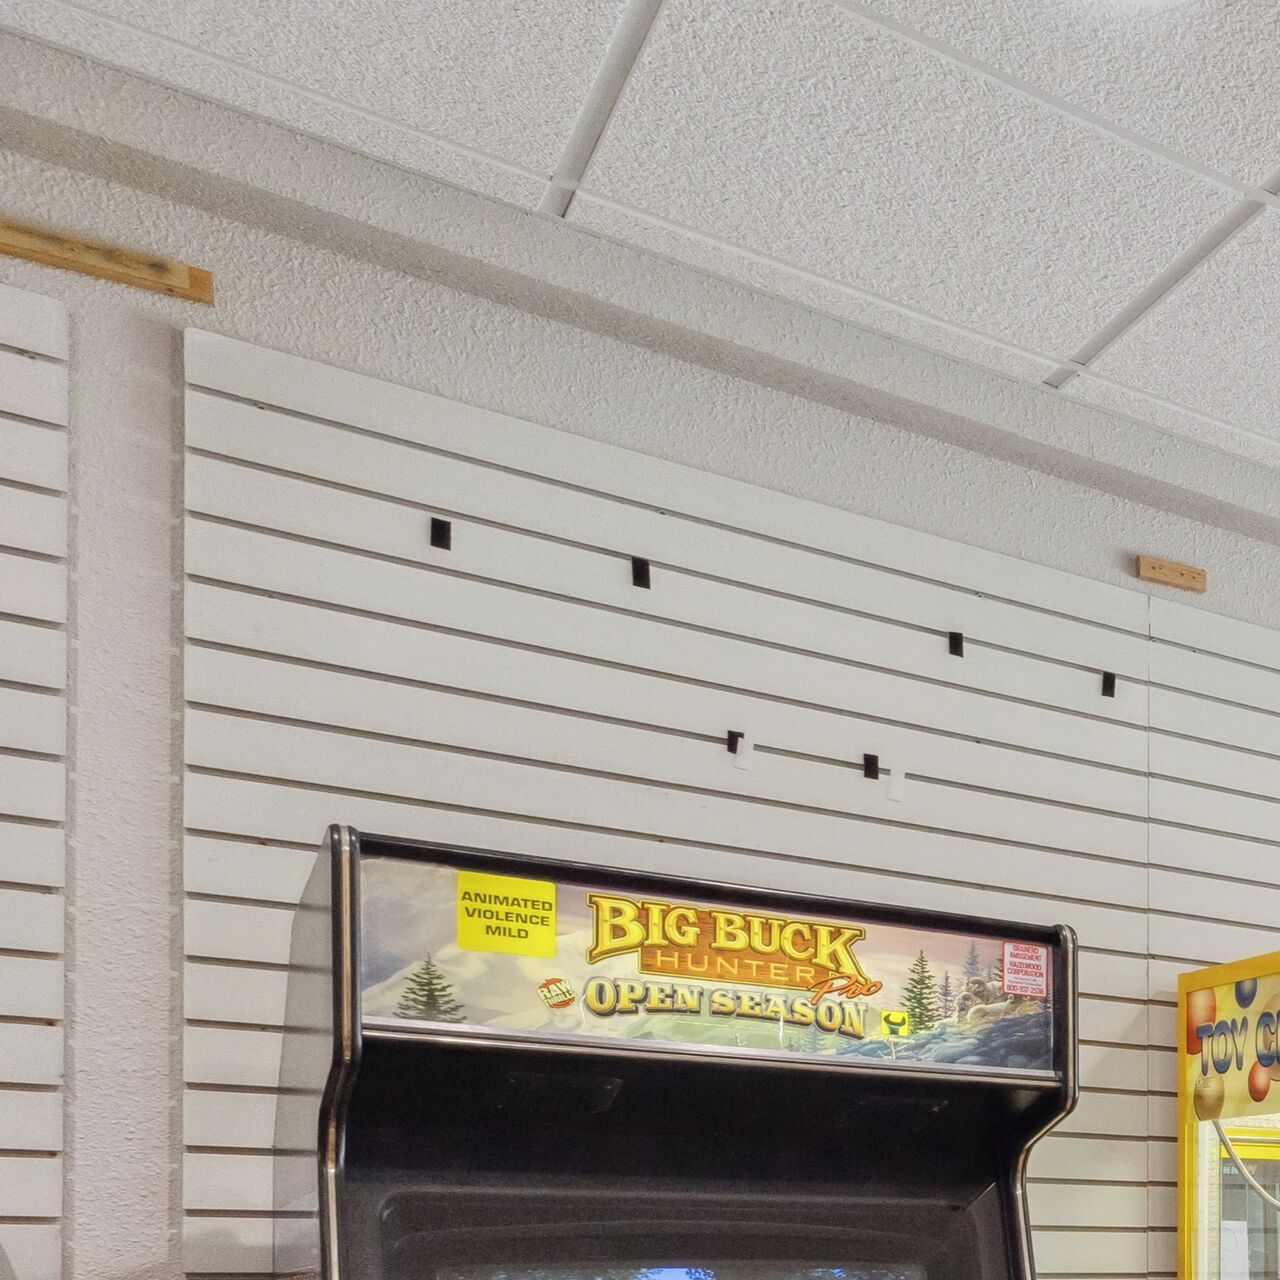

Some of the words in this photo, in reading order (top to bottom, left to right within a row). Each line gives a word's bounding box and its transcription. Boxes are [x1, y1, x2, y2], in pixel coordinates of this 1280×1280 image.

[461, 891, 553, 912] ANIMATED
[465, 907, 550, 927] VIOLENCE
[485, 925, 529, 939] MILD
[586, 893, 701, 964] BIG
[710, 910, 868, 984] BUCK
[656, 950, 816, 984] HUNTER
[537, 977, 573, 1001] RAW
[806, 973, 883, 1005] Pro
[585, 976, 703, 1017] OPEN
[710, 989, 868, 1039] SEASON
[1196, 1013, 1249, 1076] TOY
